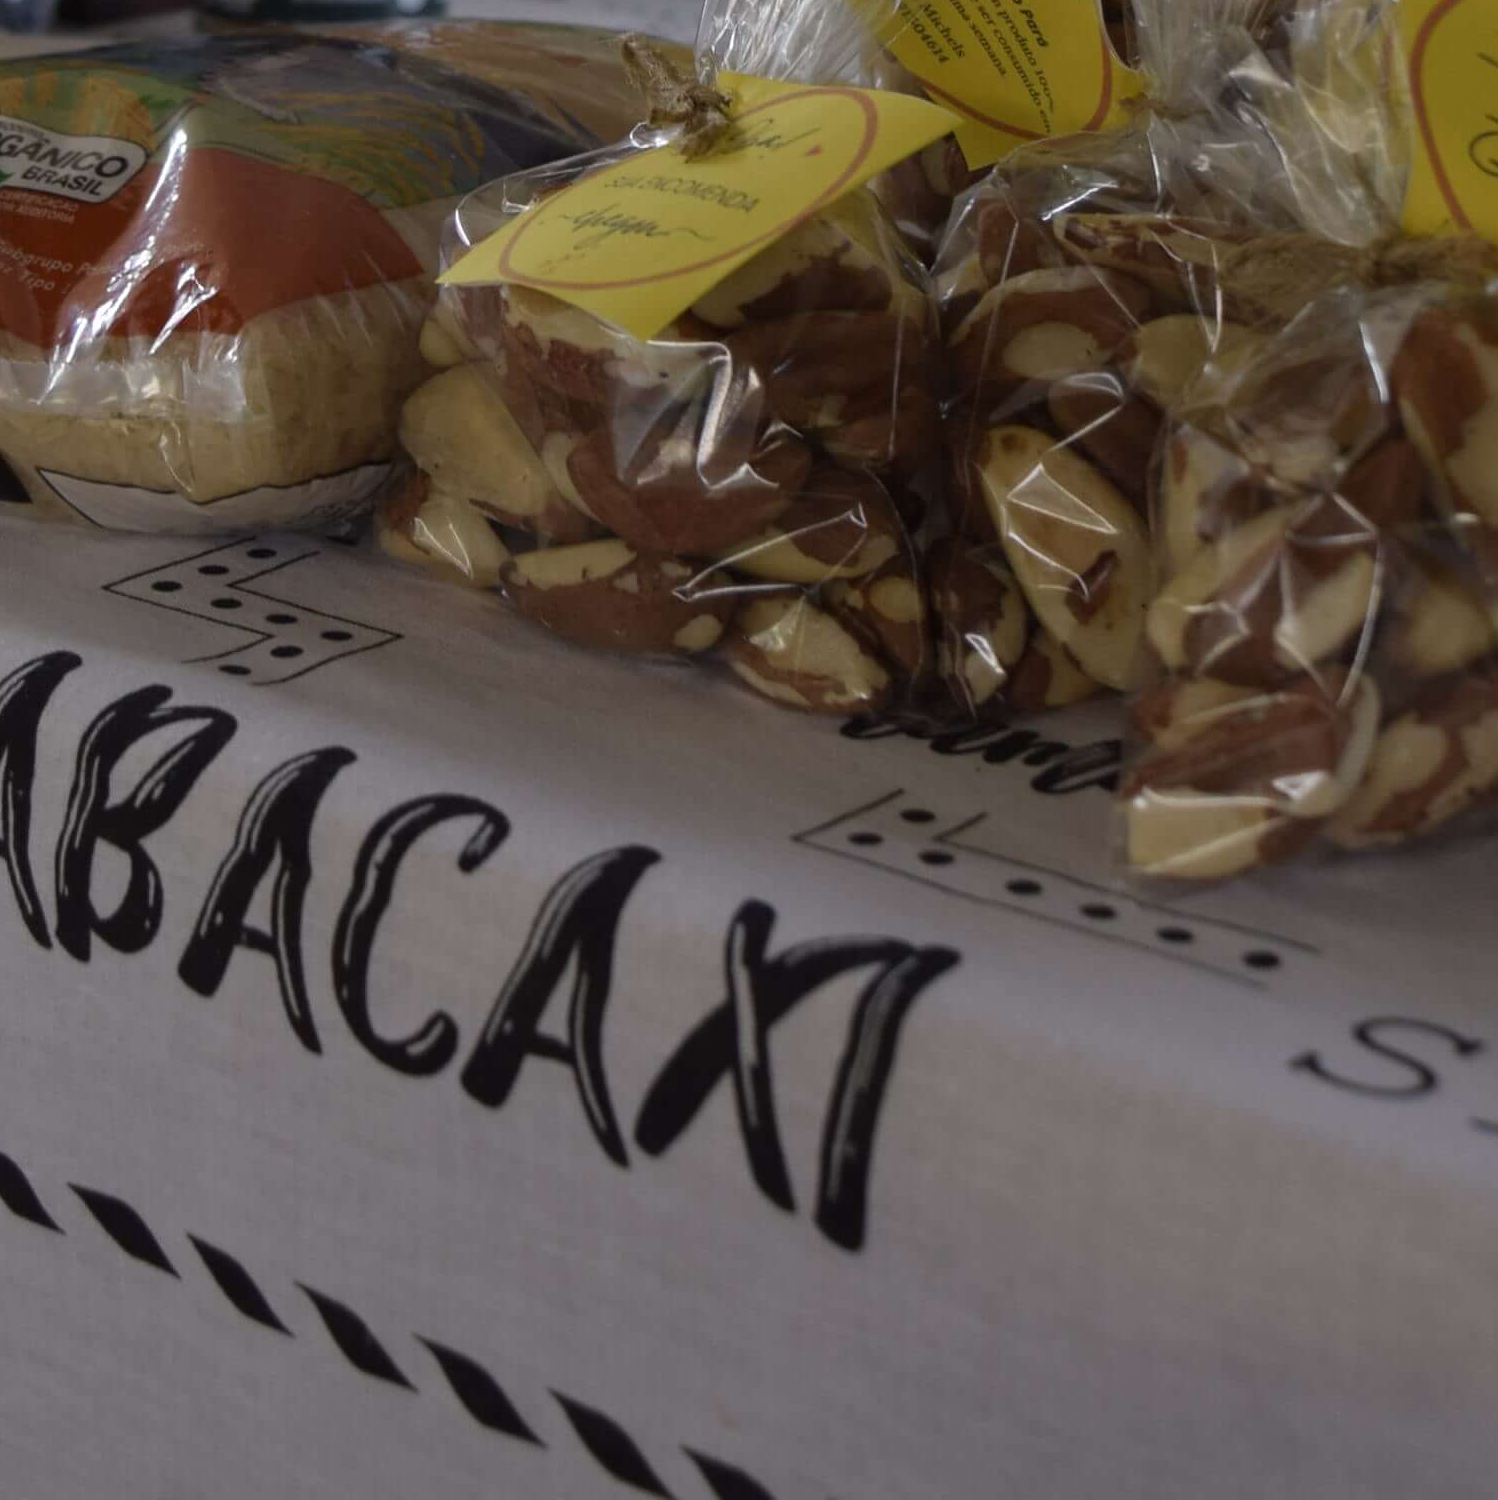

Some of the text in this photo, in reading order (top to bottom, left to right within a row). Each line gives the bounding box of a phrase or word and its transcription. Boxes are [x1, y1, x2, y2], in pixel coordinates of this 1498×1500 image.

[976, 2, 997, 29] ser
[992, 27, 1043, 108] consumido
[999, 9, 1038, 68] produto
[20, 164, 104, 197] BRASIL
[17, 268, 56, 292] Tipo
